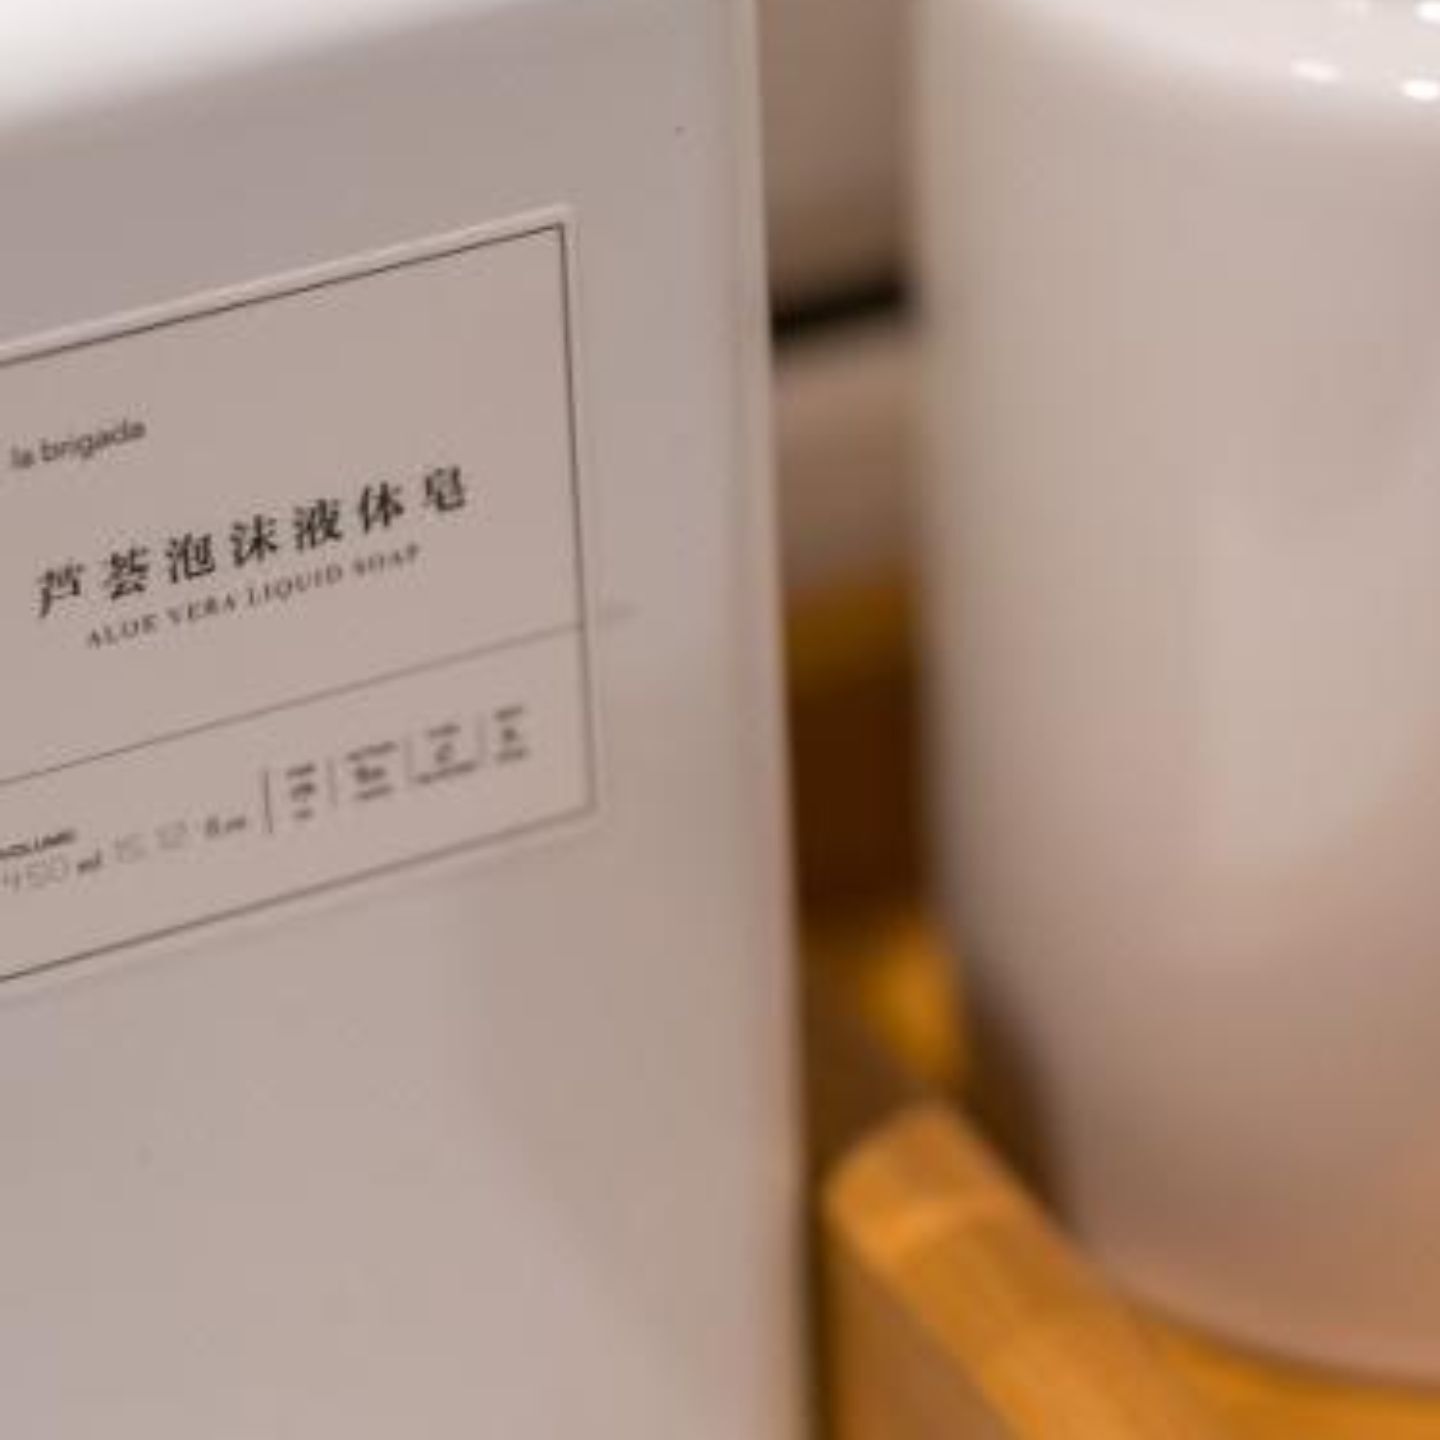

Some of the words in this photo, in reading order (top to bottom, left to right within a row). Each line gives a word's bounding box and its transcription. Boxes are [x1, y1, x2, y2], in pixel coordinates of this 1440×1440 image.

[11, 442, 36, 470] la
[40, 418, 146, 464] brigada
[37, 465, 466, 619] 芦荟泡沫液体皂
[87, 613, 158, 648] ALOE
[166, 592, 237, 625] VERA
[247, 563, 343, 607] LIQUID
[353, 544, 420, 576] SOAP
